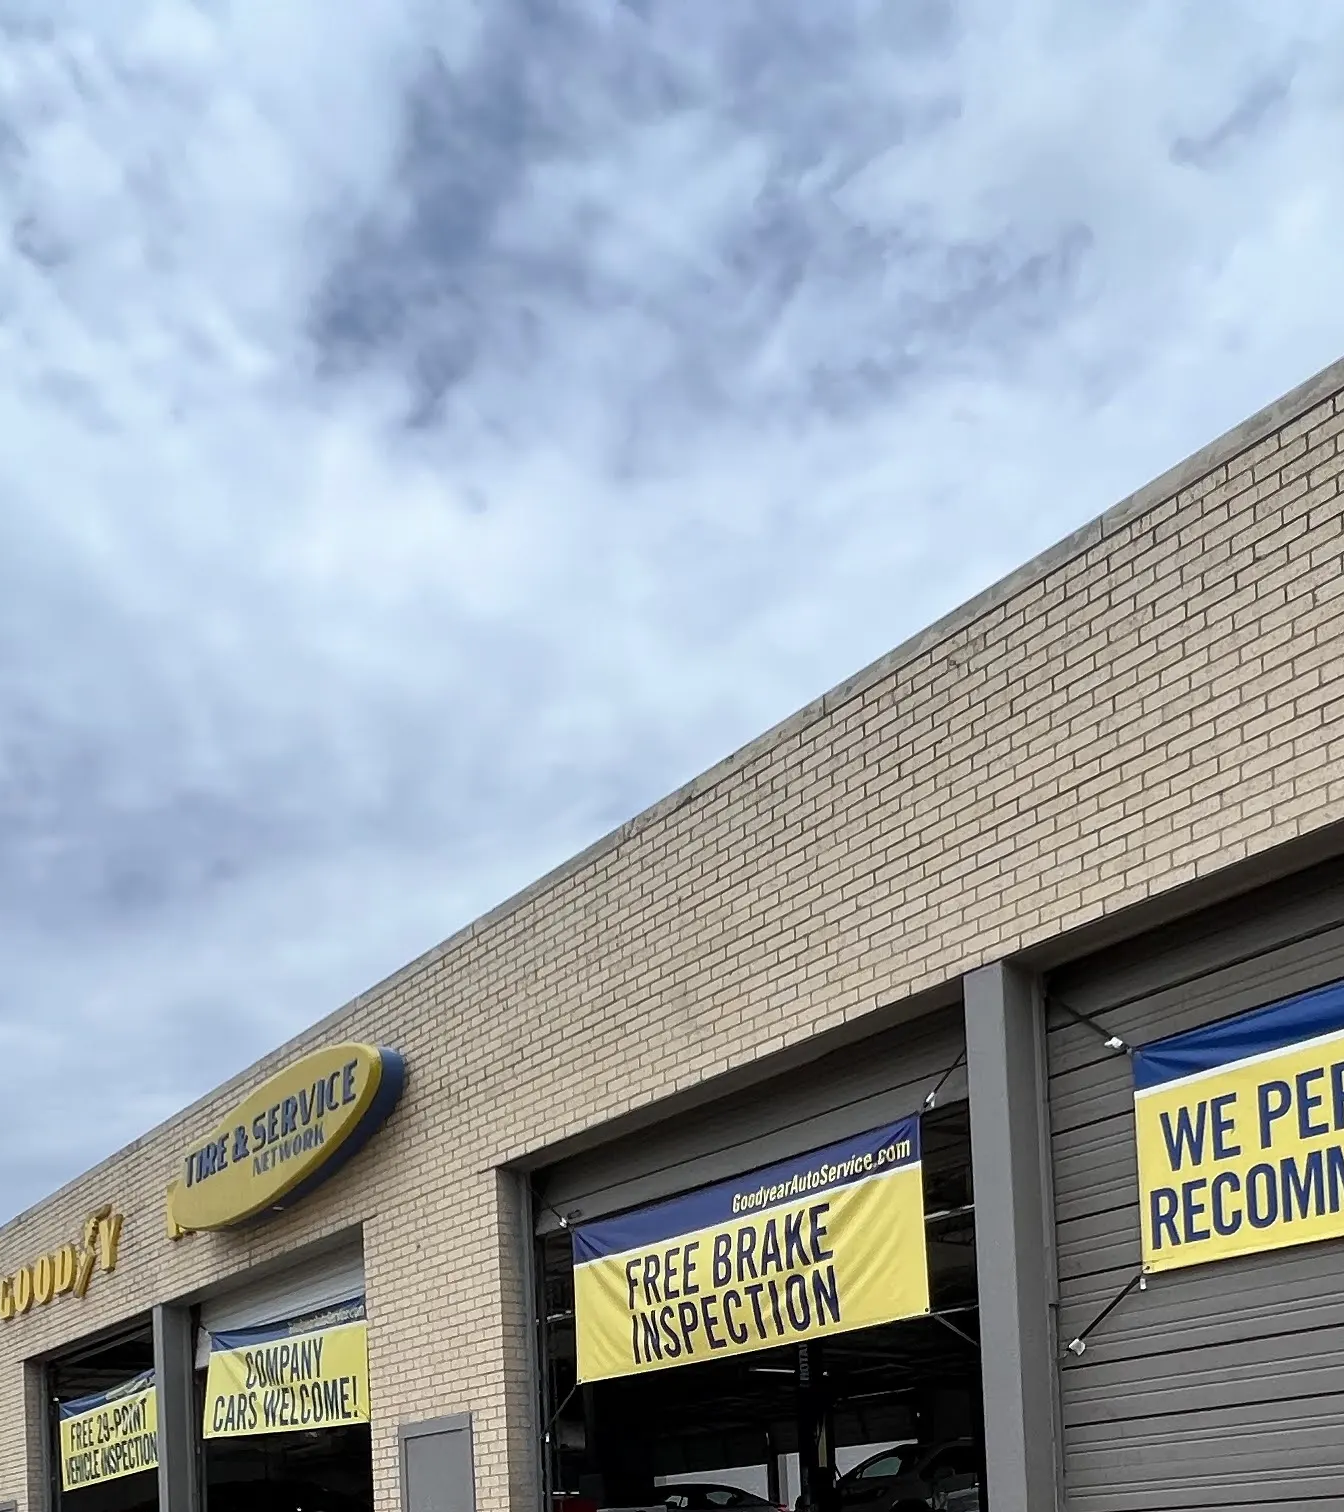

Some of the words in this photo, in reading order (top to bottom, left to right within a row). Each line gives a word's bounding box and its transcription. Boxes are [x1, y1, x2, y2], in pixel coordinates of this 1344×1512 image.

[184, 1132, 230, 1188] TIRE
[231, 1125, 251, 1163] &
[251, 1058, 359, 1153] SERVICE
[251, 1123, 325, 1177] NETWORK
[1159, 1092, 1243, 1173] WE
[731, 1138, 912, 1215] GoodyearAutoService.com
[625, 1242, 701, 1310] FREE
[712, 1203, 835, 1288] BRAKE
[630, 1264, 842, 1366] INSPECTION
[244, 1336, 324, 1390] COMPANY
[70, 1417, 95, 1453] FREE
[96, 1397, 148, 1445] 29-POINT
[212, 1391, 258, 1432] CARS
[263, 1375, 359, 1428] WELCOME!
[65, 1449, 101, 1486] VEHICLE
[101, 1431, 159, 1477] INSPECTION
